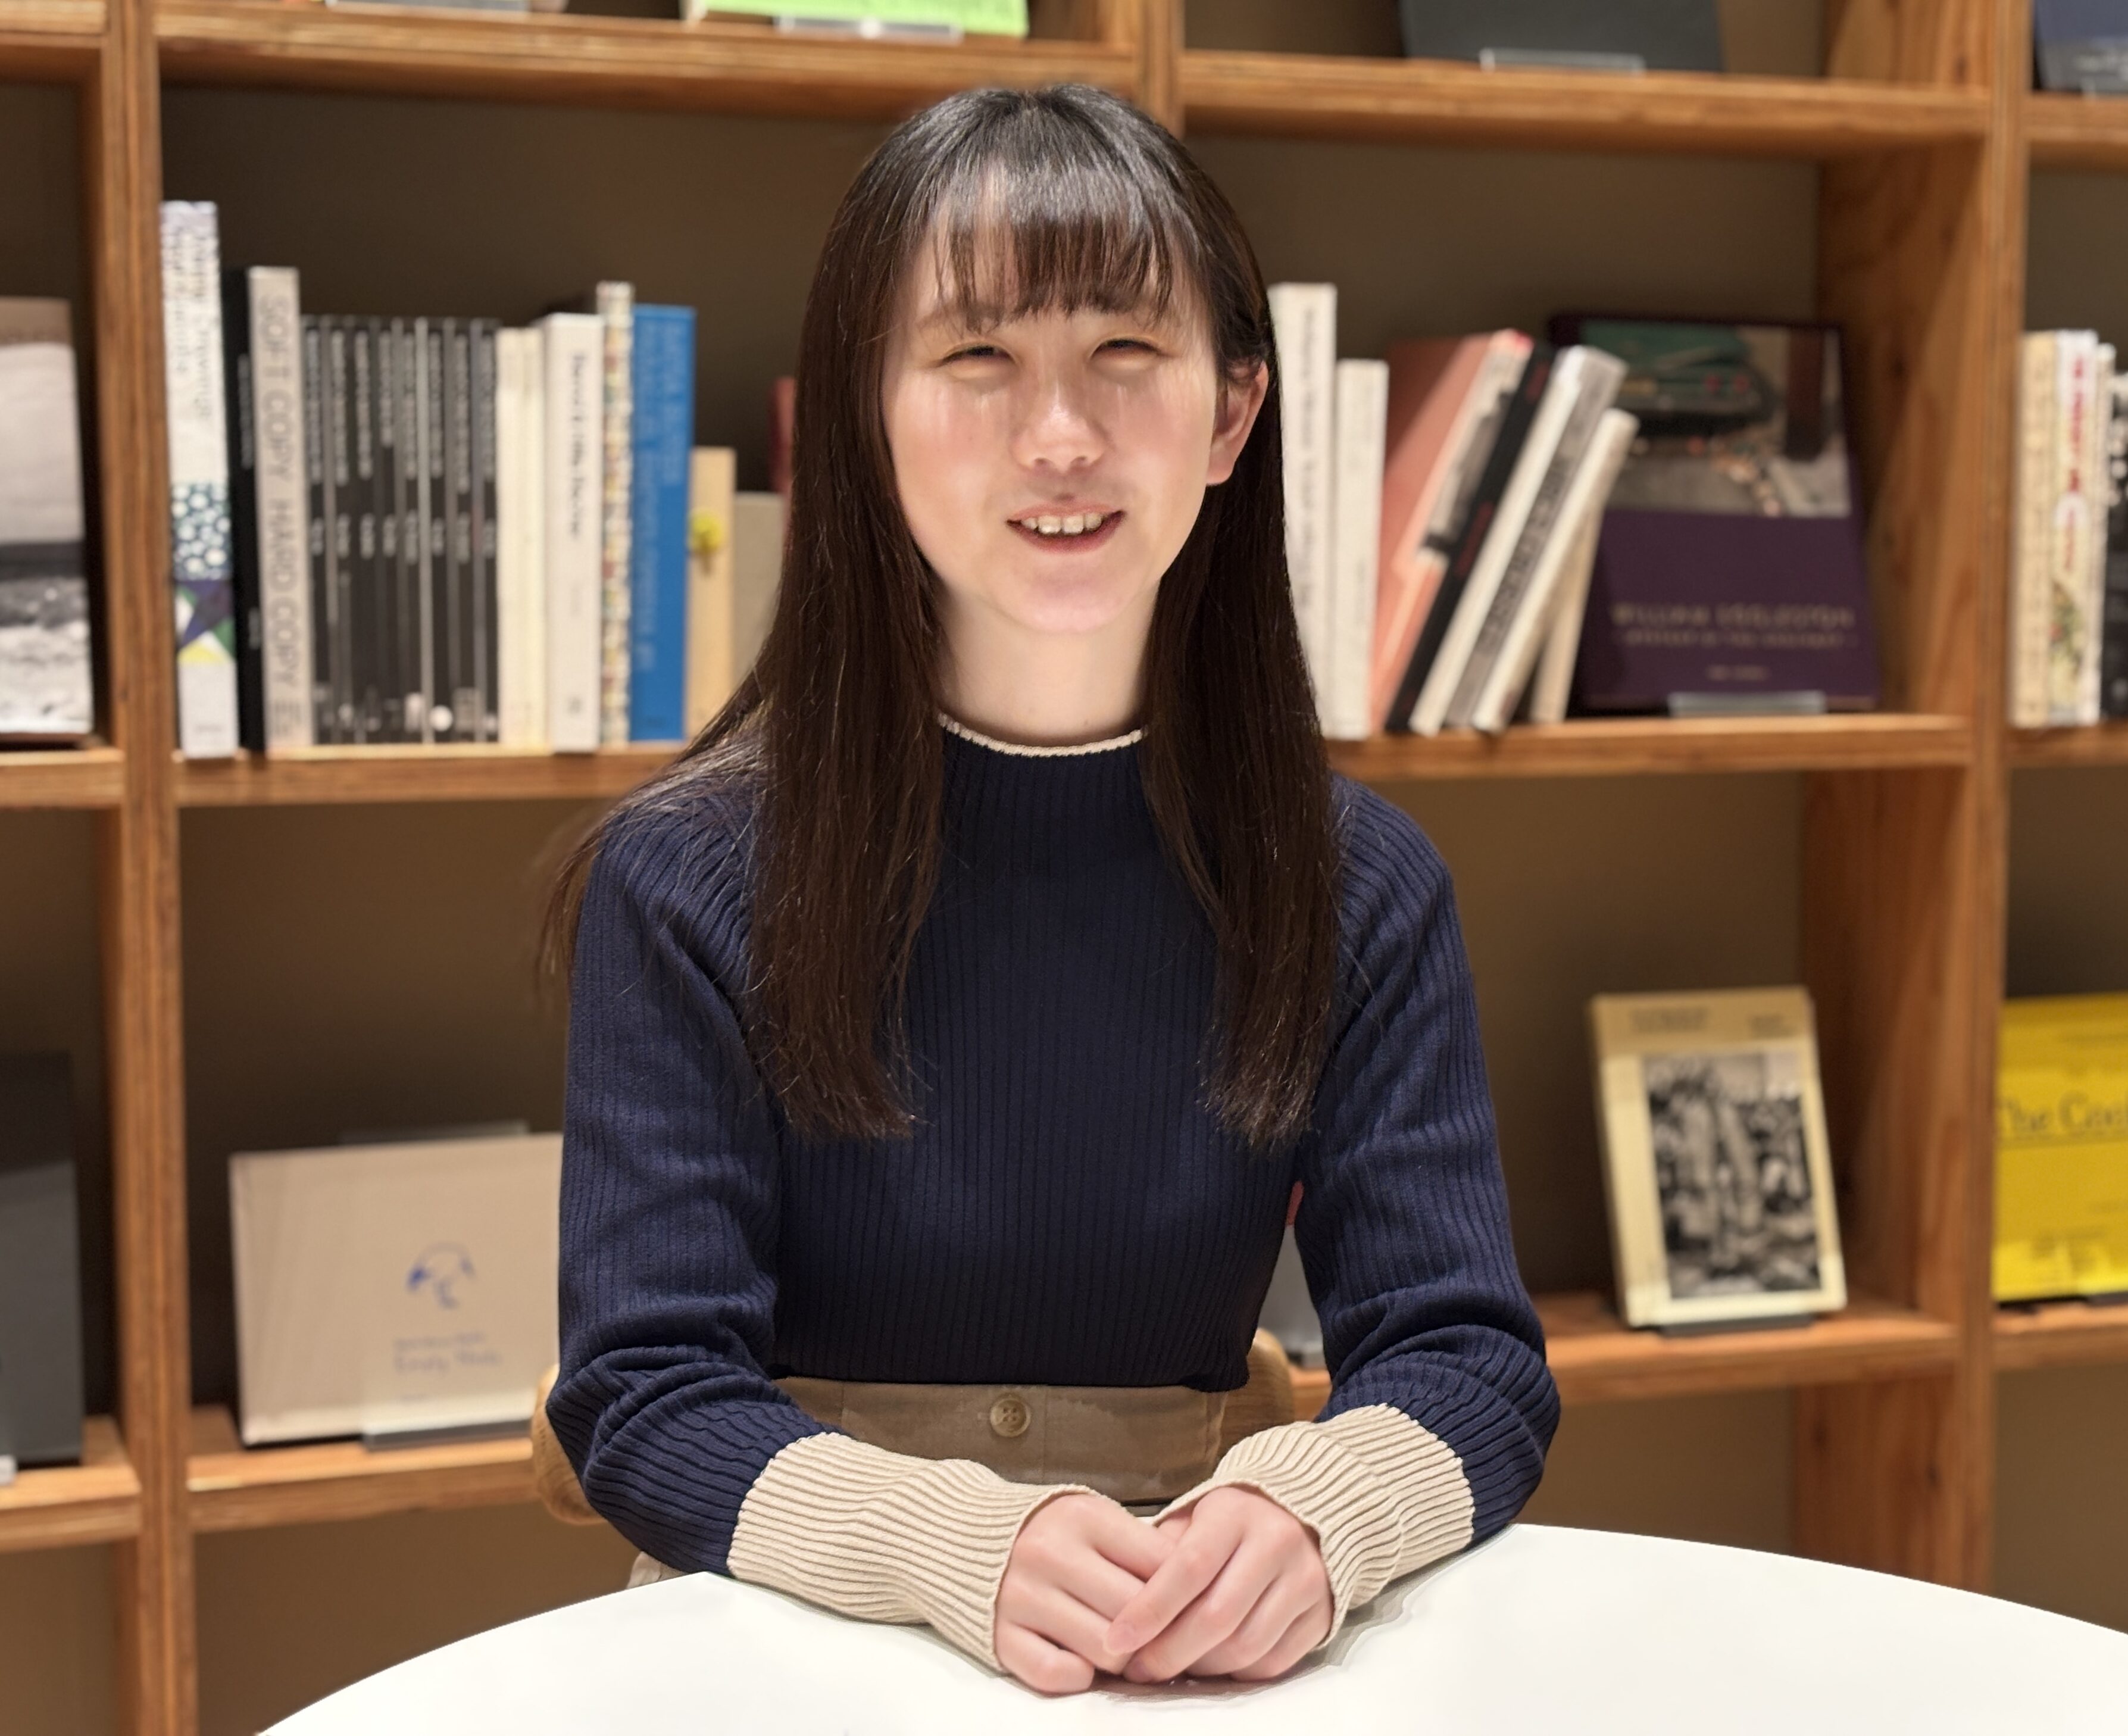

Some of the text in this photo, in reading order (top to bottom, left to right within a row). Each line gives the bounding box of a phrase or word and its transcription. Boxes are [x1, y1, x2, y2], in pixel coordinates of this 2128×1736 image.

[258, 295, 293, 380] SOFT
[263, 390, 296, 480] COPY
[265, 499, 298, 591] HARD
[269, 597, 302, 688] COPY
